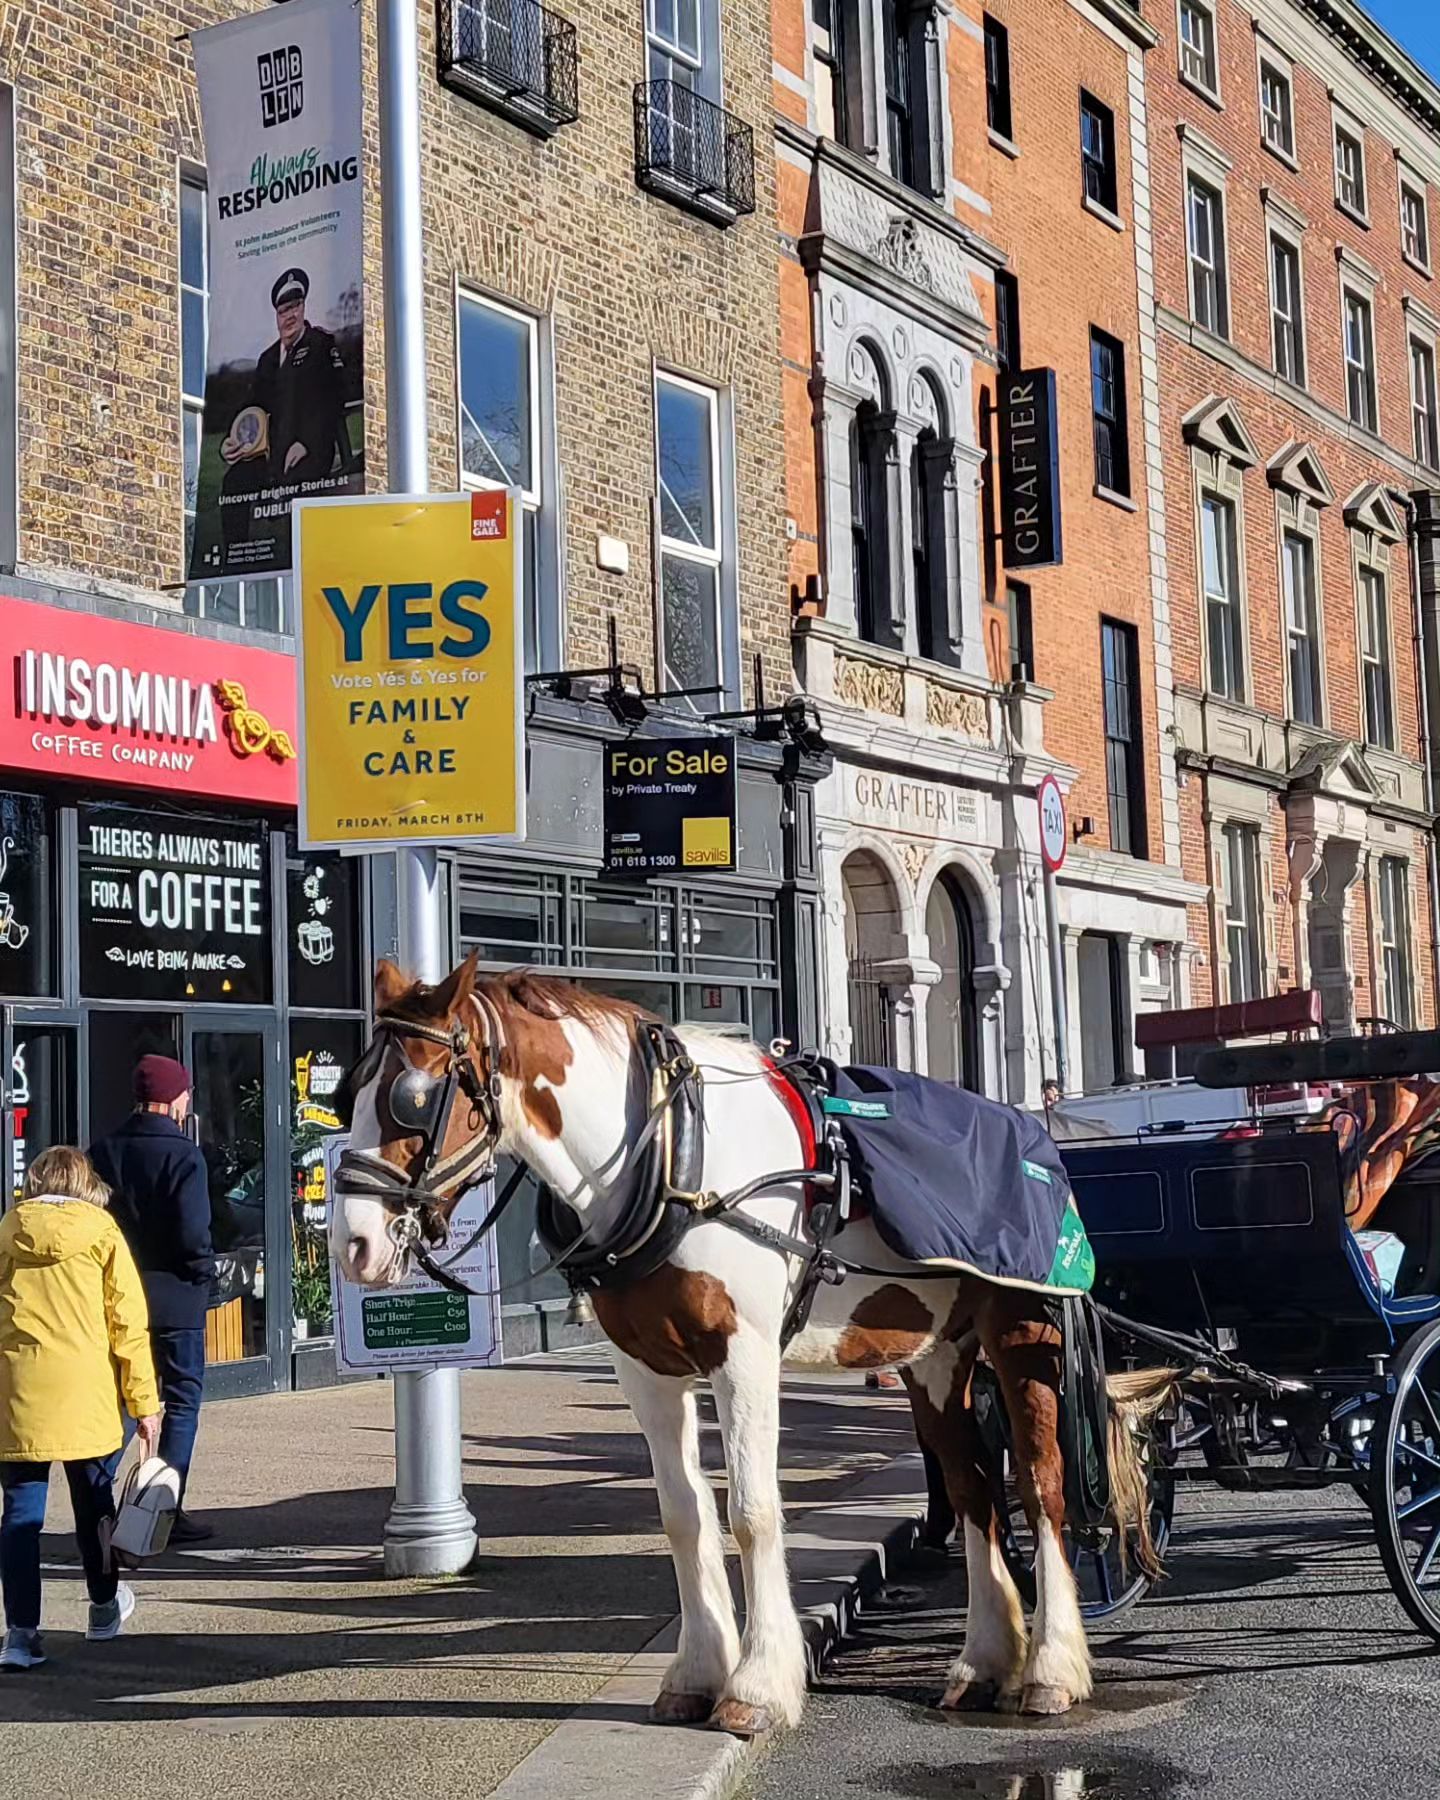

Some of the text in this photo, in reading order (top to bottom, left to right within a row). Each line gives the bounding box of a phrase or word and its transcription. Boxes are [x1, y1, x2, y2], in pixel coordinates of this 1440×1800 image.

[250, 147, 320, 189] Always
[218, 156, 358, 220] RESPONDING
[261, 223, 299, 240] Ambulance
[300, 210, 341, 228] Volunteers
[262, 243, 278, 253] lives
[298, 223, 338, 241] community
[1009, 381, 1040, 555] GRAFTER
[218, 475, 349, 506] Uncover Brighter Stories at
[473, 527, 501, 537] GAEL
[474, 518, 497, 528] FINE
[321, 579, 492, 663] YES
[331, 667, 488, 689] Vote Yes & Yes for
[24, 649, 217, 743] INSOMNIA
[349, 696, 470, 725] FAMILY
[402, 729, 416, 744] &
[31, 731, 195, 773] COFFEE COMPANY
[363, 749, 457, 777] CARE
[611, 749, 728, 776] For Sale
[611, 783, 697, 797] by Private Treaty
[855, 774, 948, 822] GRAFTER
[399, 814, 450, 826] MARCH
[456, 813, 485, 825] 8TH
[1043, 808, 1063, 835] TAXI
[89, 825, 260, 871] THERES ALWAYS TIME
[611, 855, 676, 867] 01 618 1300
[685, 848, 728, 864] savills
[91, 869, 262, 935] FOR A COFFEE
[127, 949, 227, 971] LOVE BEING AWAKE
[364, 1299, 391, 1310] Short
[366, 1312, 387, 1323] Half
[366, 1328, 385, 1338] One
